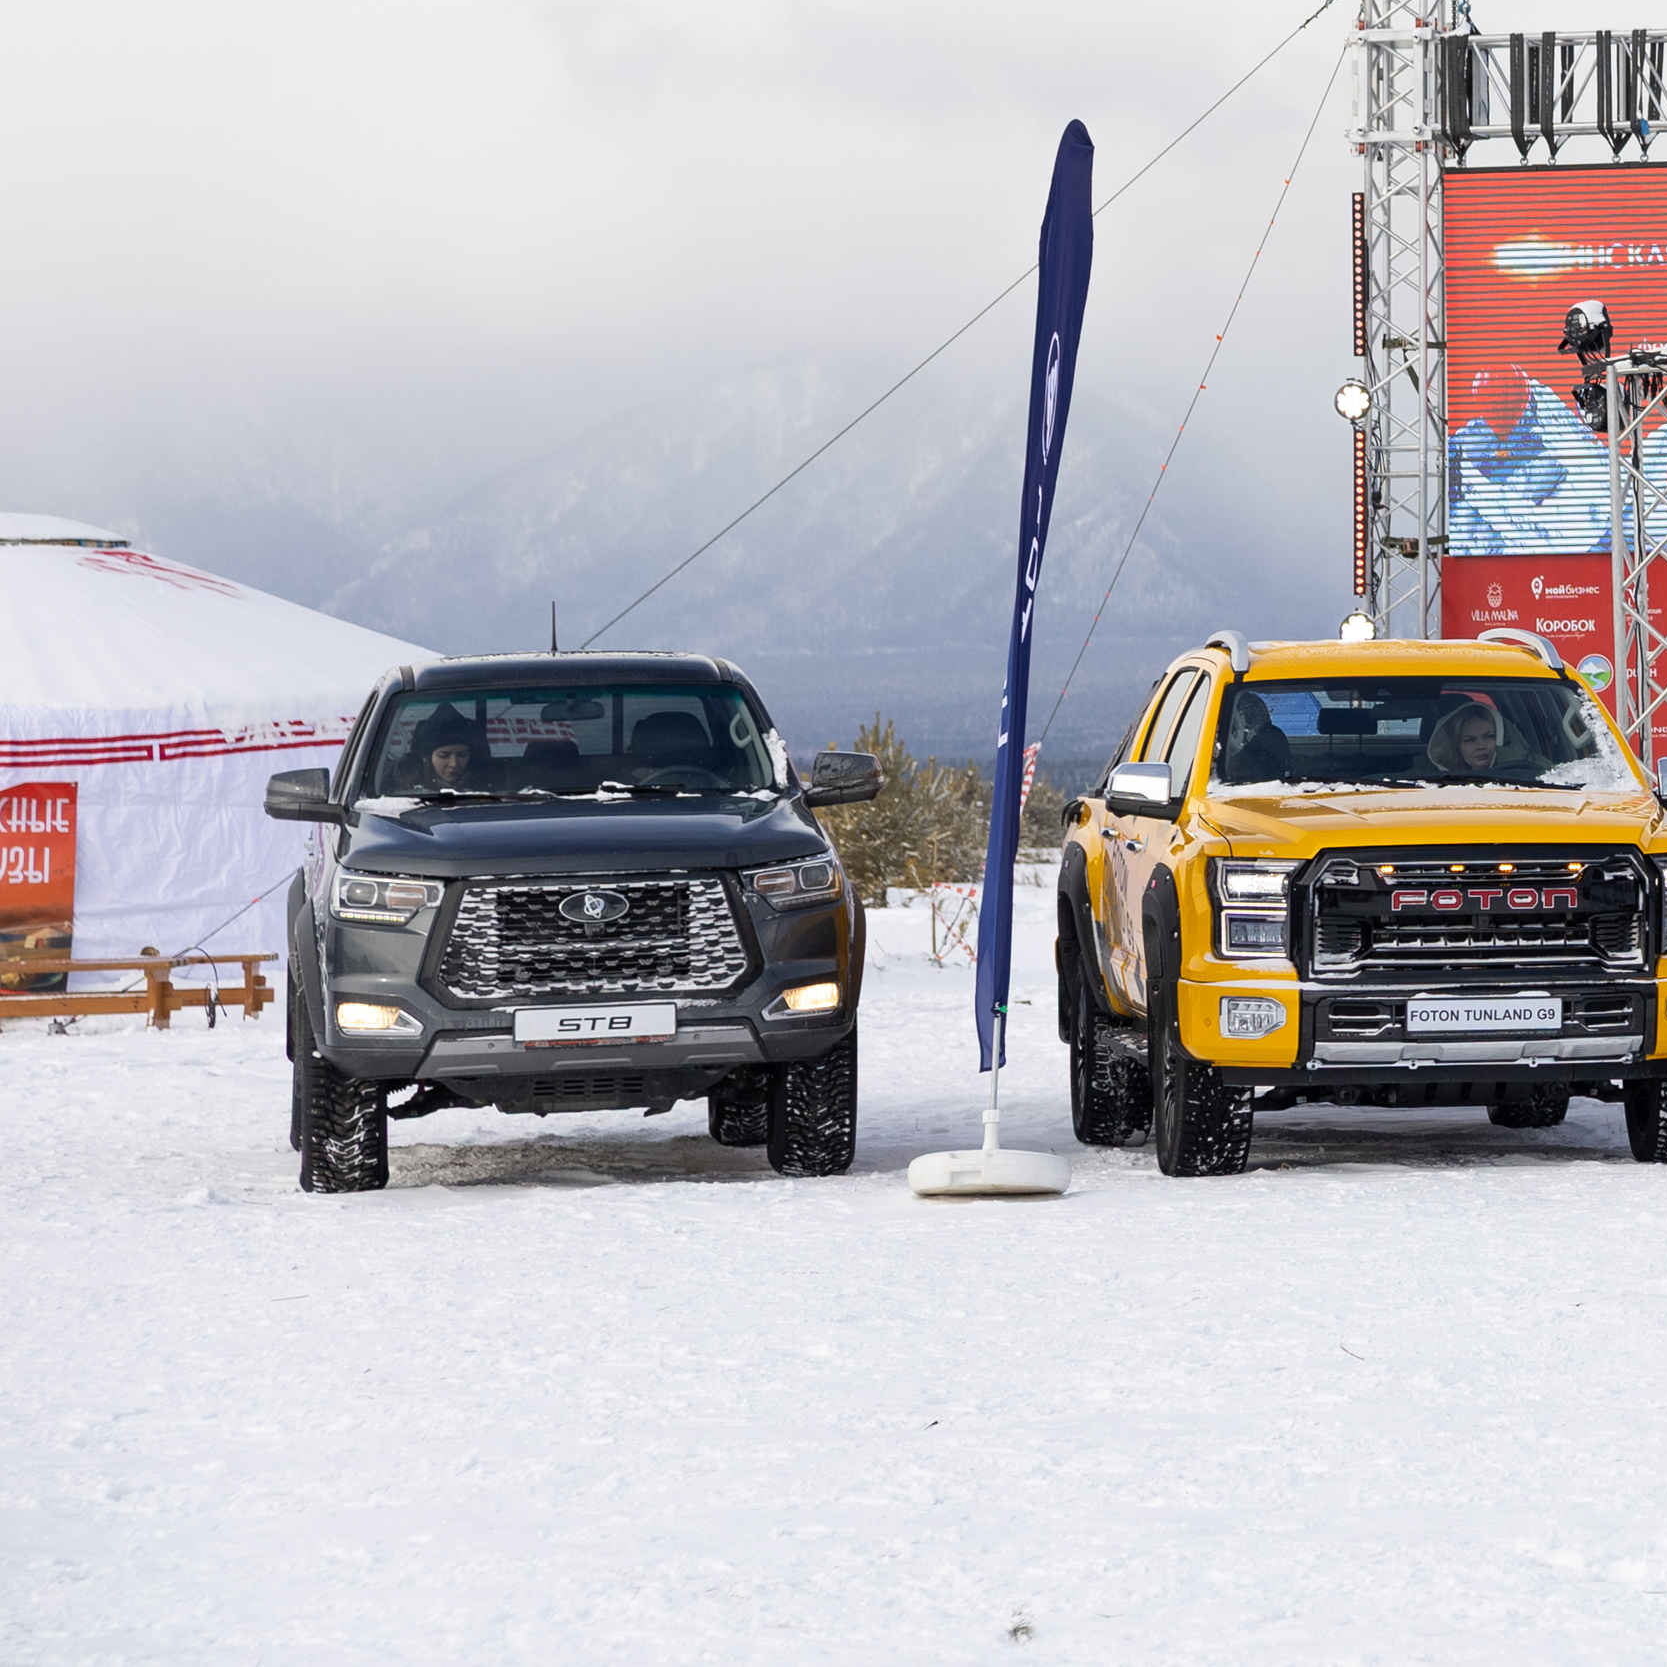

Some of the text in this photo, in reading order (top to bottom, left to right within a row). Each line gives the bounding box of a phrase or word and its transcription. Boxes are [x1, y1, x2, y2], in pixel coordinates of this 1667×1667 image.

[1536, 618, 1596, 633] КОРОБОК
[1410, 1008, 1556, 1022] FOTON TUNLAND G9
[557, 1016, 633, 1032] ST8
